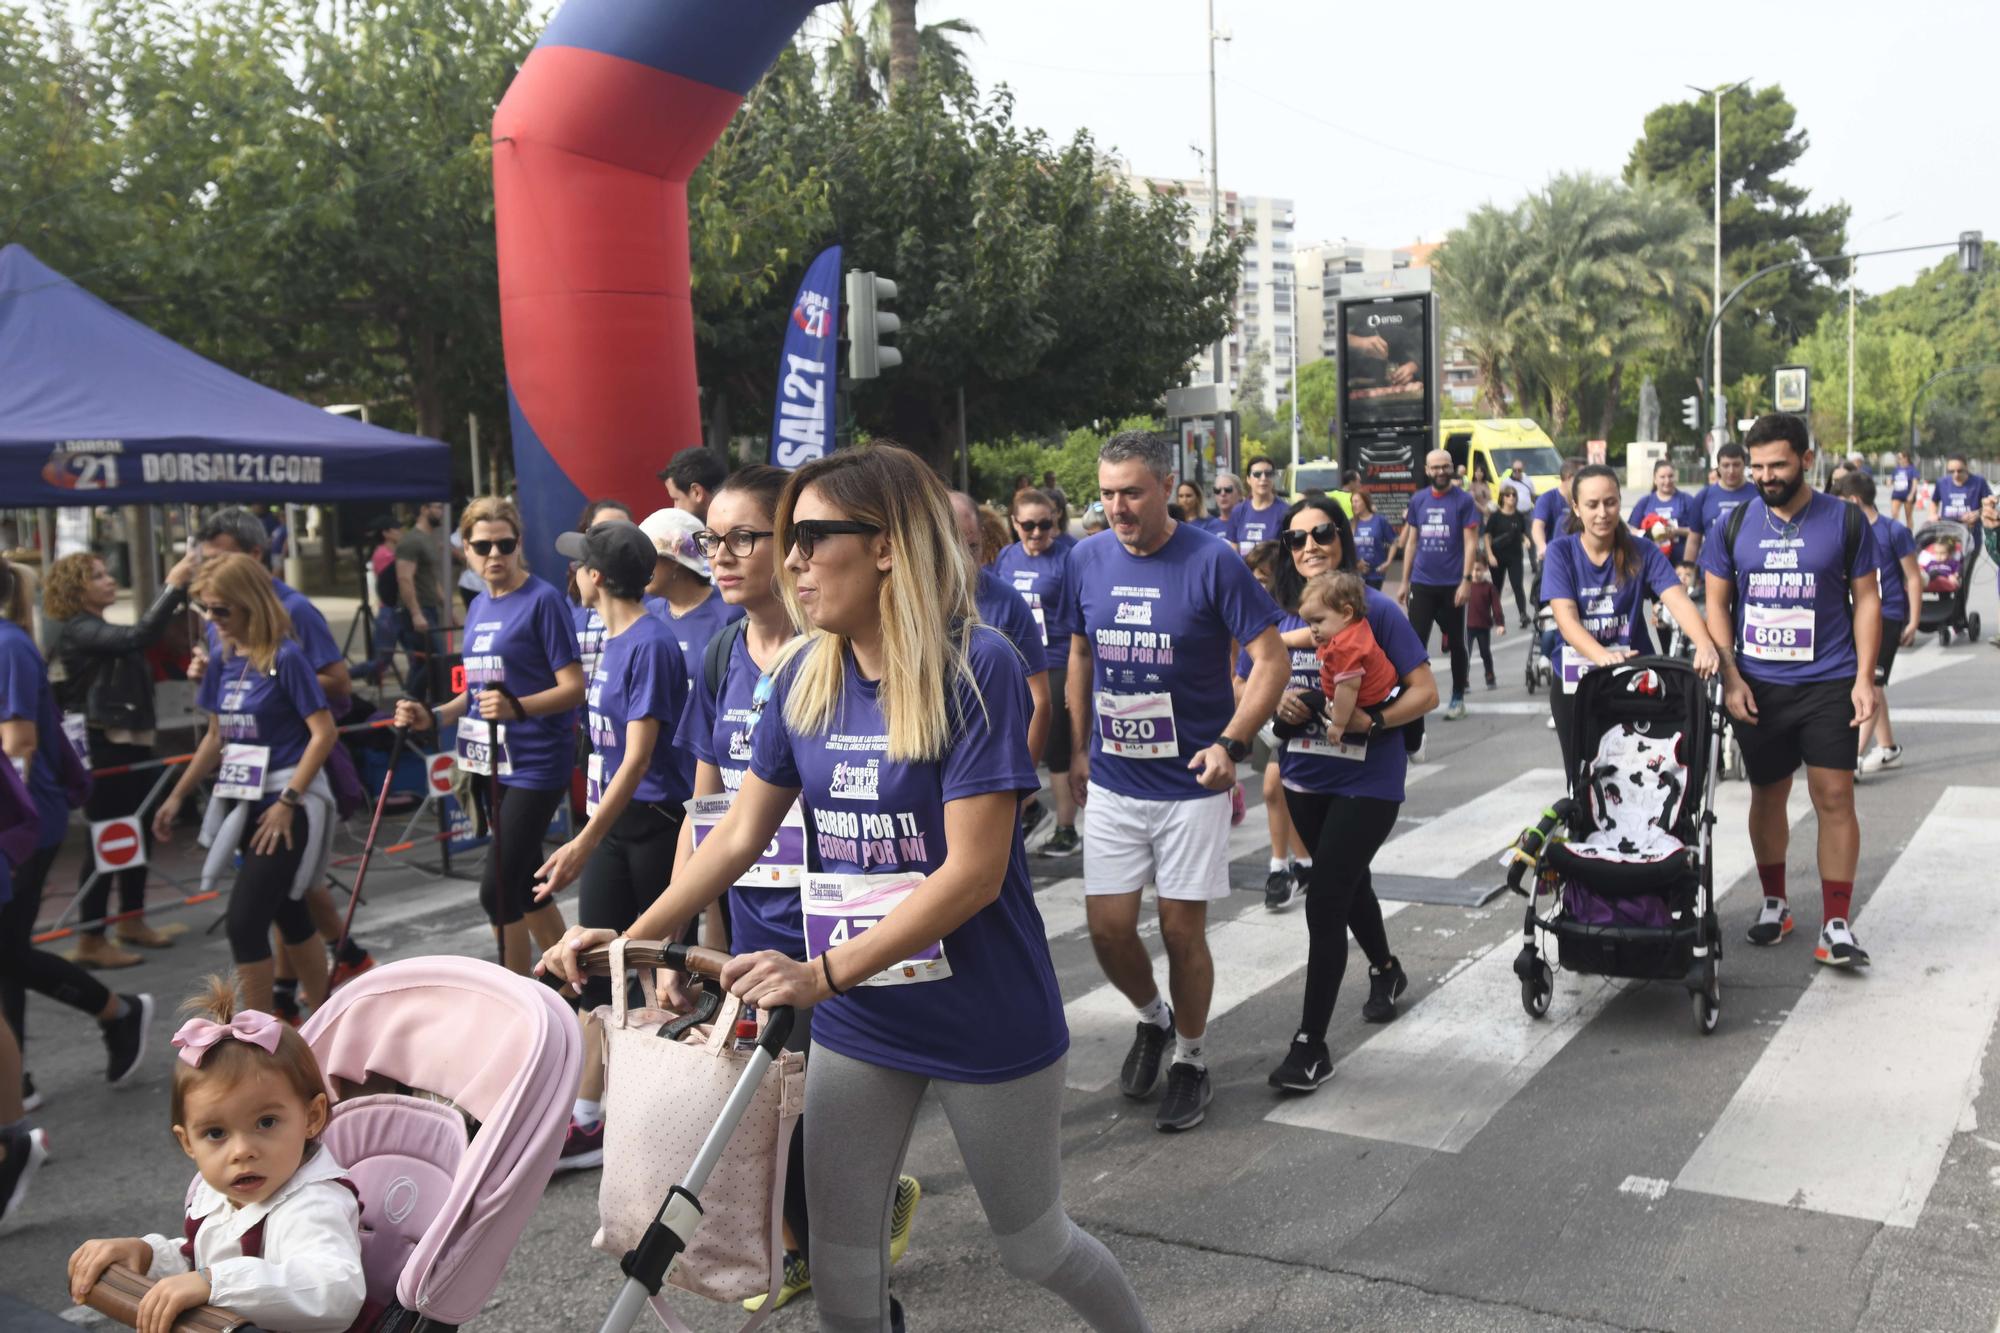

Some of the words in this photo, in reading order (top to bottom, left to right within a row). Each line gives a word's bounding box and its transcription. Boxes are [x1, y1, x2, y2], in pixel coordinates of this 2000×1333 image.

[73, 455, 118, 490] 21
[142, 452, 322, 484] DORSAL21.COM
[1749, 573, 1780, 586] CORRO
[1782, 573, 1802, 586] POR
[1805, 573, 1814, 585] TI
[1748, 585, 1778, 598] CORRO
[1780, 585, 1800, 598] POR
[1096, 629, 1131, 647] CORRO
[1134, 631, 1157, 649] POR
[1159, 633, 1171, 649] TI
[1755, 627, 1796, 646] 608
[1097, 645, 1128, 662] CORRO
[1131, 646, 1154, 664] POR
[1112, 719, 1155, 739] 620
[825, 741, 843, 750] CONTRA
[843, 742, 849, 750] EL
[846, 767, 878, 777] CARRERA
[866, 758, 879, 767] 2022
[844, 784, 877, 795] CIUDADES
[855, 777, 865, 785] DE
[866, 777, 878, 786] LAS
[814, 808, 859, 839] CORRO
[861, 813, 895, 840] POR
[896, 812, 918, 837] TI
[817, 833, 858, 864] CORRO
[861, 840, 897, 869] POR
[899, 832, 927, 862] MÍ
